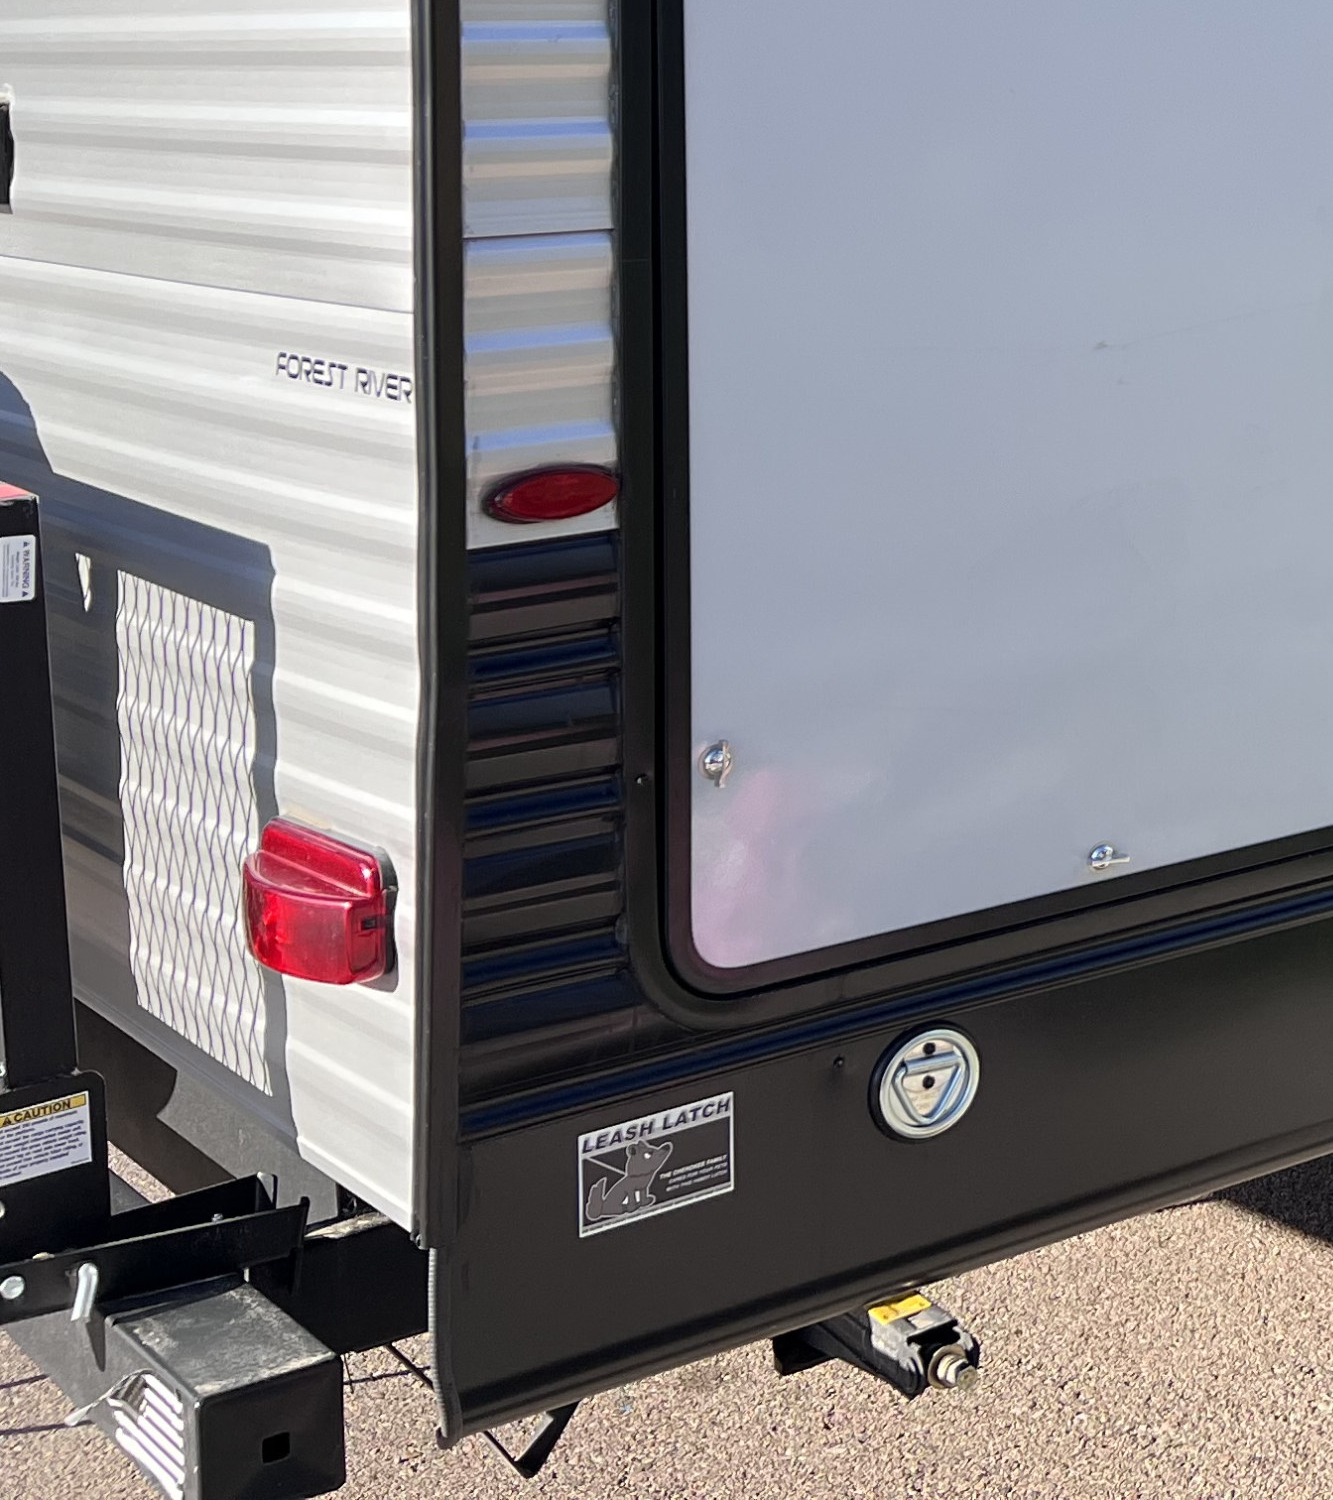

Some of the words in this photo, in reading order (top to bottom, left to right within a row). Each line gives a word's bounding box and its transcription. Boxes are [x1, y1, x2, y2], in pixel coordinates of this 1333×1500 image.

[276, 351, 348, 390] FOREST
[354, 367, 413, 403] RIVER
[14, 1098, 71, 1123] CAUTION
[581, 1122, 655, 1154] LEASH
[662, 1097, 732, 1130] LATCH
